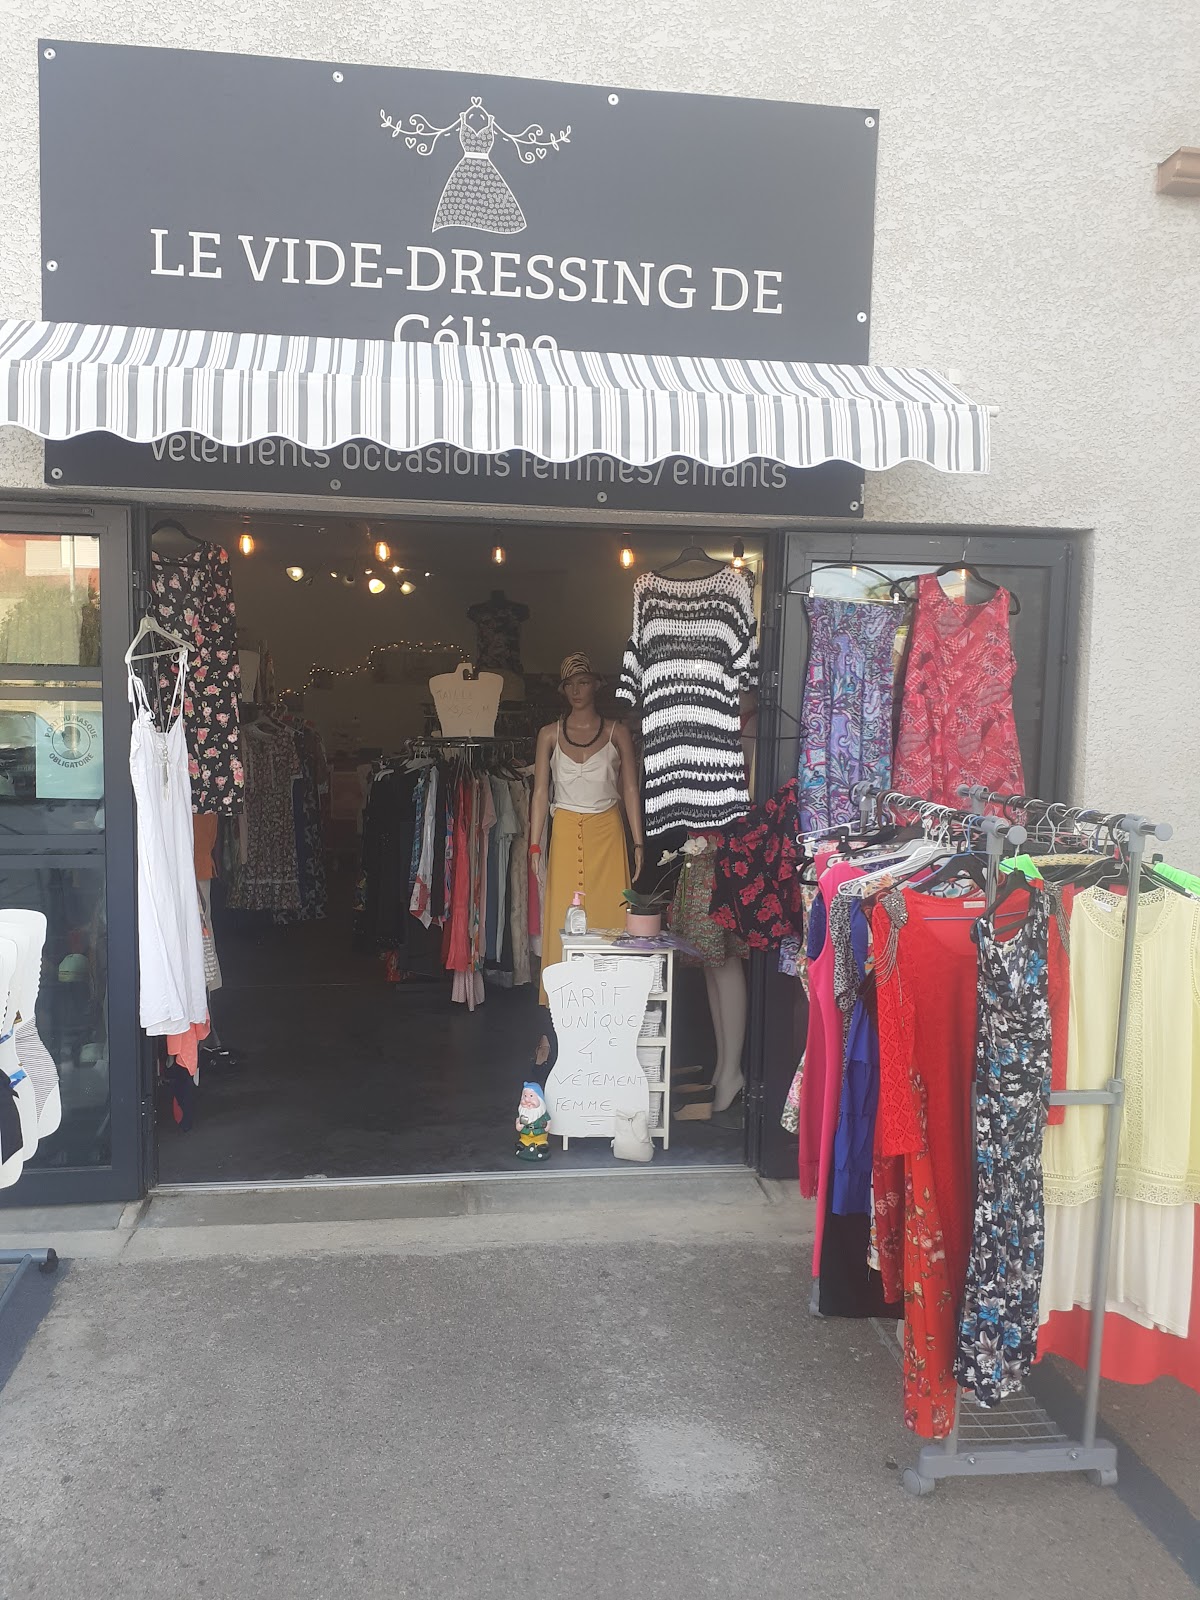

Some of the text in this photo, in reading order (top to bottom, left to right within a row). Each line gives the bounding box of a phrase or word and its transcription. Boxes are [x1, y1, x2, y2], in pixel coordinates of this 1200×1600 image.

[150, 228, 783, 314] LE VIDE-DRESSING DE
[342, 442, 511, 477] occasions
[72, 715, 98, 739] MASQUE
[48, 752, 94, 769] OBLIGATOIRE
[577, 1037, 597, 1064] 4
[555, 1096, 613, 1113] FEMME
